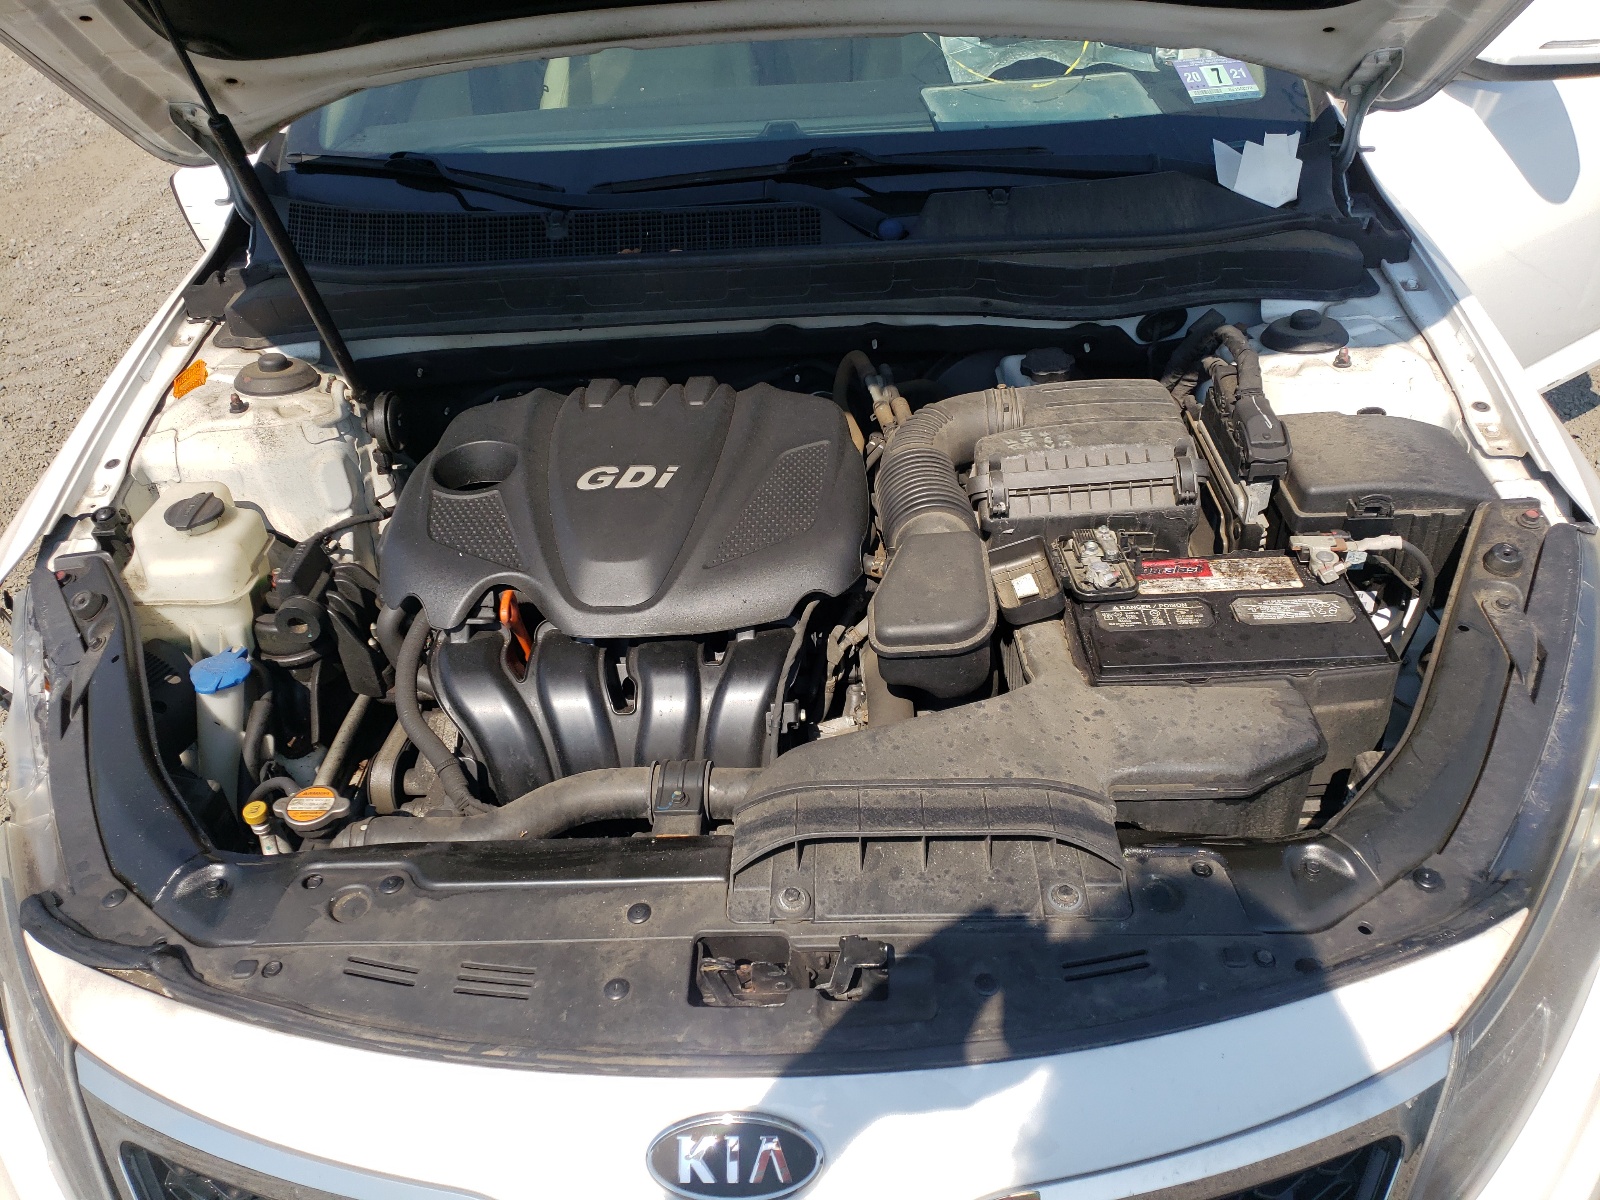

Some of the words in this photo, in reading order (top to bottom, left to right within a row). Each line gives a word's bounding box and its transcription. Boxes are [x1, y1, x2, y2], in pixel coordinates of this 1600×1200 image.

[1184, 71, 1202, 83] 20
[1211, 68, 1223, 84] 7
[1229, 67, 1247, 79] 21
[576, 465, 680, 491] GDi
[677, 1135, 793, 1184] KIA
